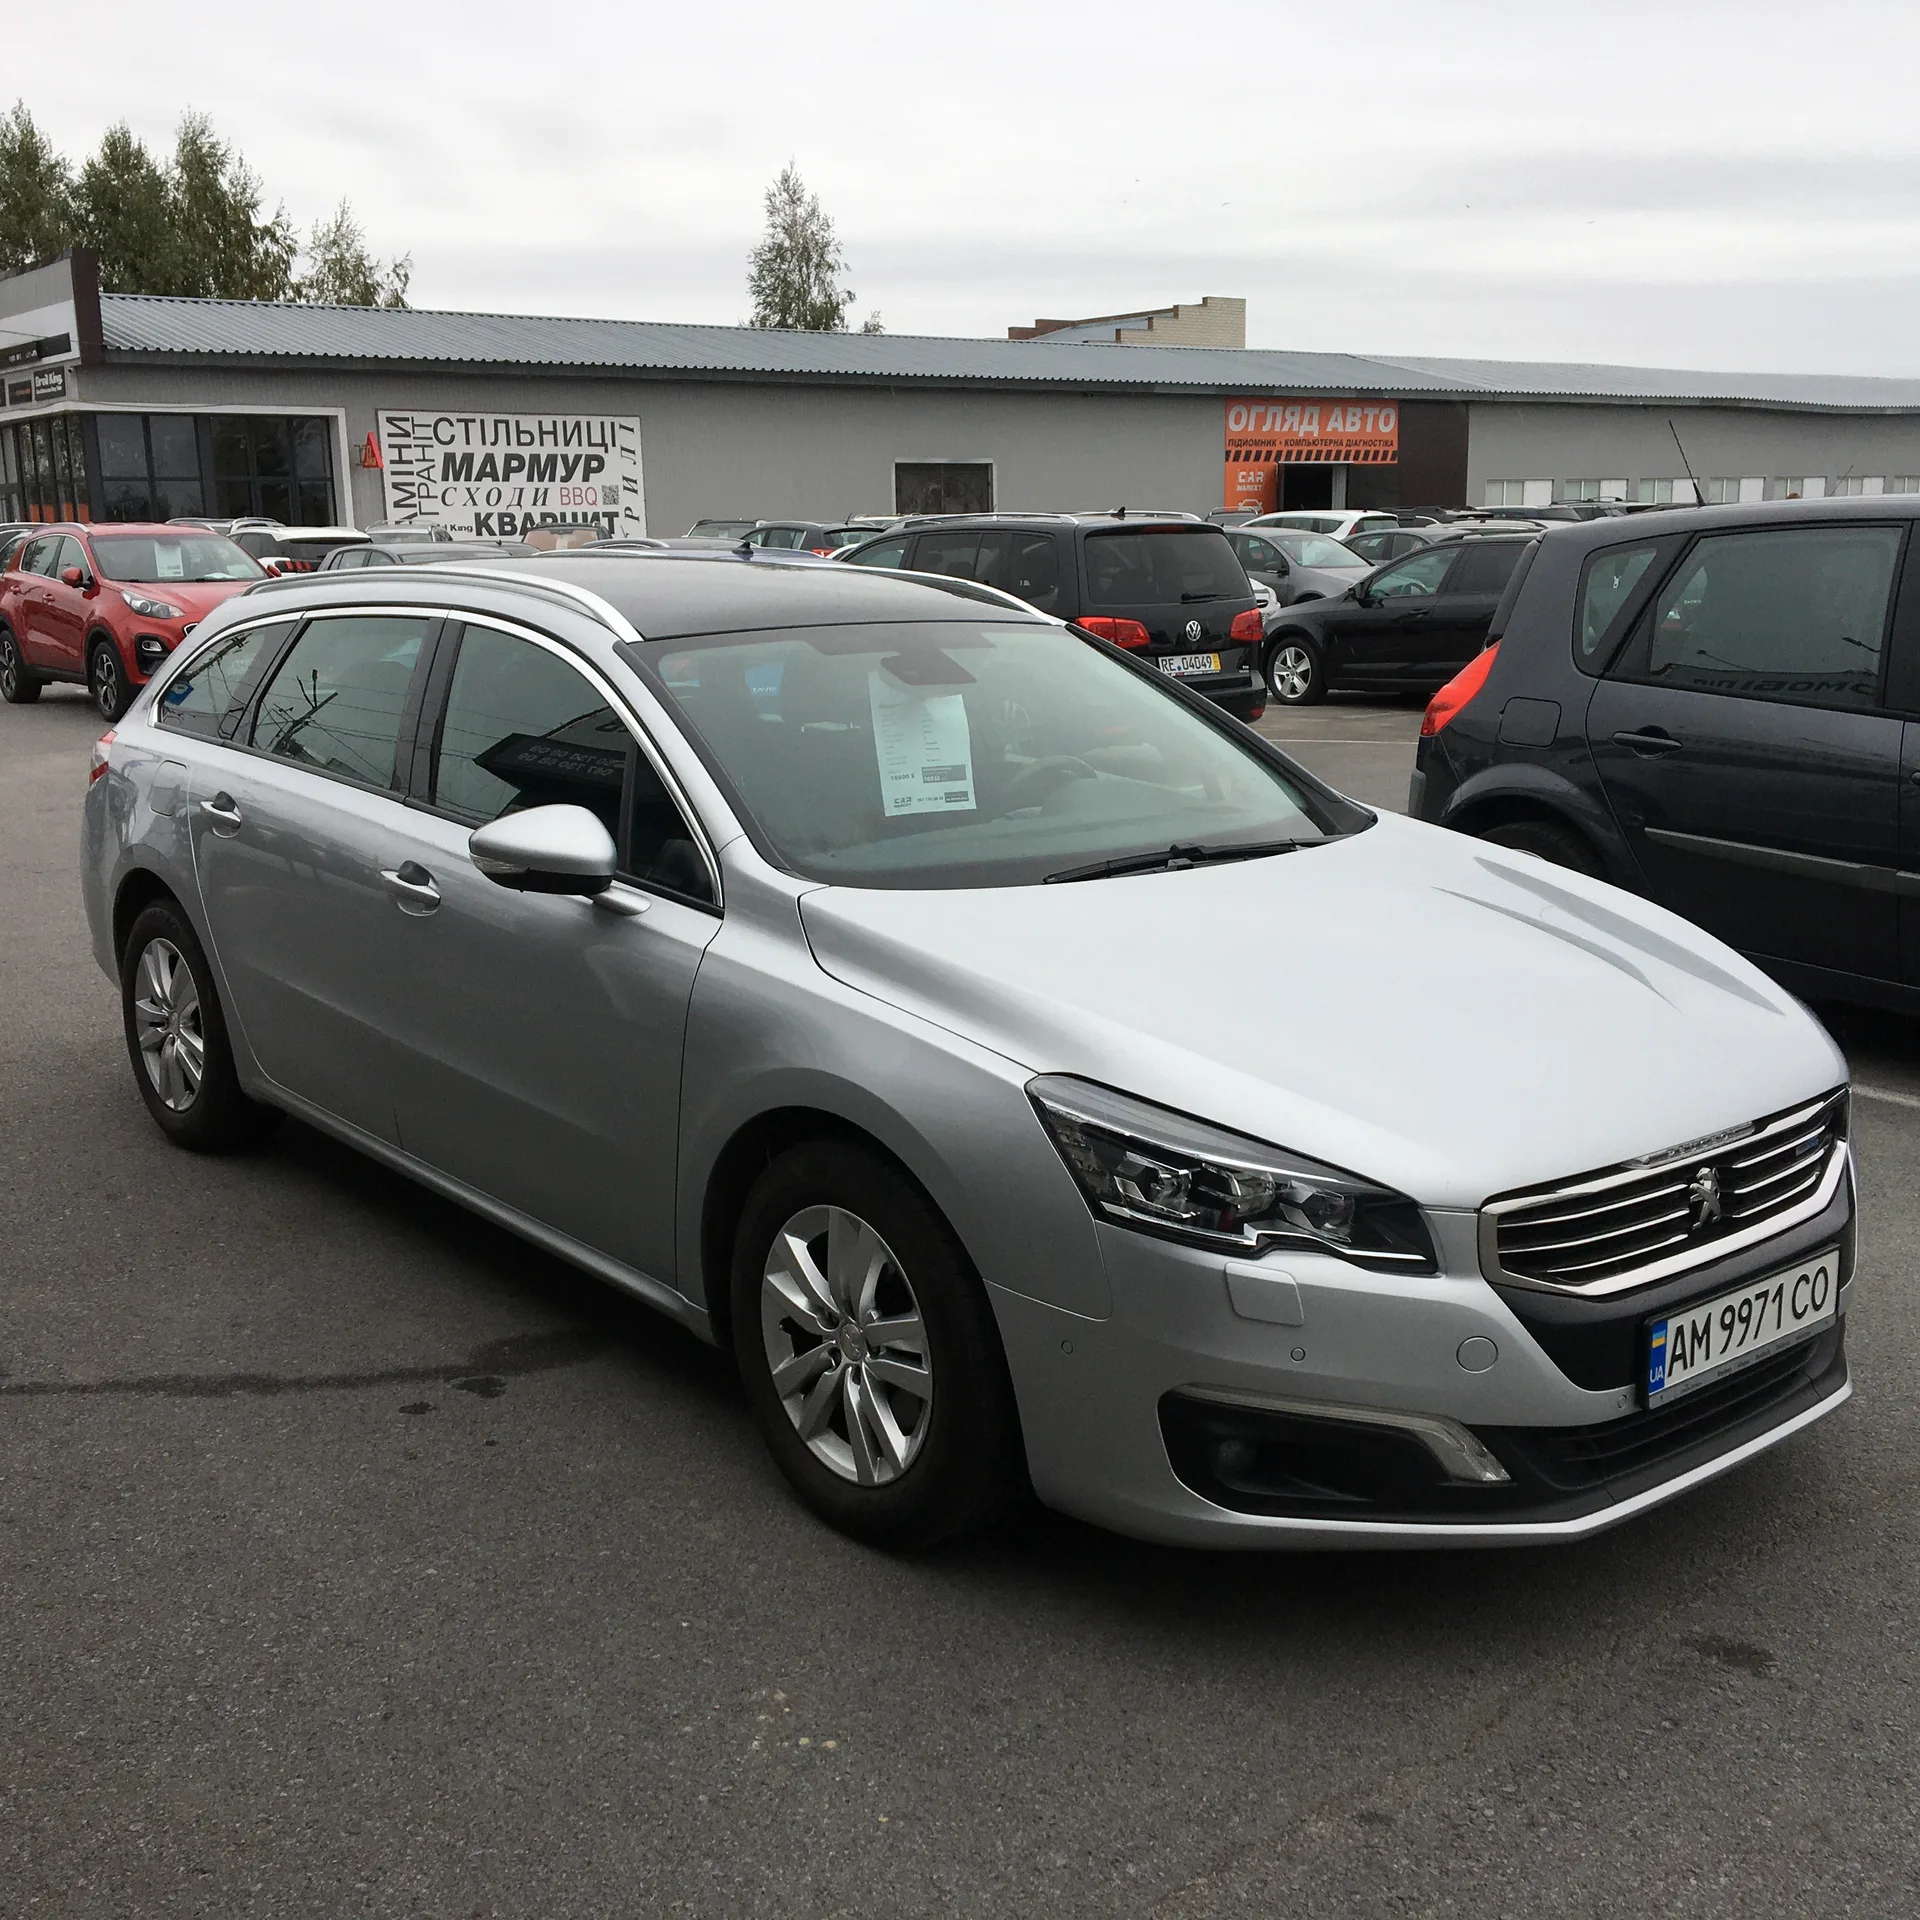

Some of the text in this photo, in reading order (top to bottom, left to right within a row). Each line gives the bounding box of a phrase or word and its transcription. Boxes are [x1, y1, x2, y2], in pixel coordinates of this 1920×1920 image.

[1228, 404, 1396, 437] ОГЛЯД АВТО
[432, 416, 617, 454] СТІЛЬНИЦІ
[1227, 438, 1278, 448] ПІДЙОМНИК
[1345, 439, 1394, 448] ДІАГНОСТІКА
[411, 416, 440, 516] ГРАНІТ
[440, 452, 606, 483] МАРМУР
[1238, 471, 1264, 483] CAR
[619, 422, 640, 538] РИЛІ
[1236, 484, 1263, 492] MARKET
[440, 486, 551, 511] СХОДИ
[559, 486, 598, 507] BBQ
[1161, 658, 1176, 673] RE
[1181, 655, 1213, 671] 04049
[1667, 1265, 1829, 1378] AM 9971 CO
[1650, 1365, 1664, 1384] UA
